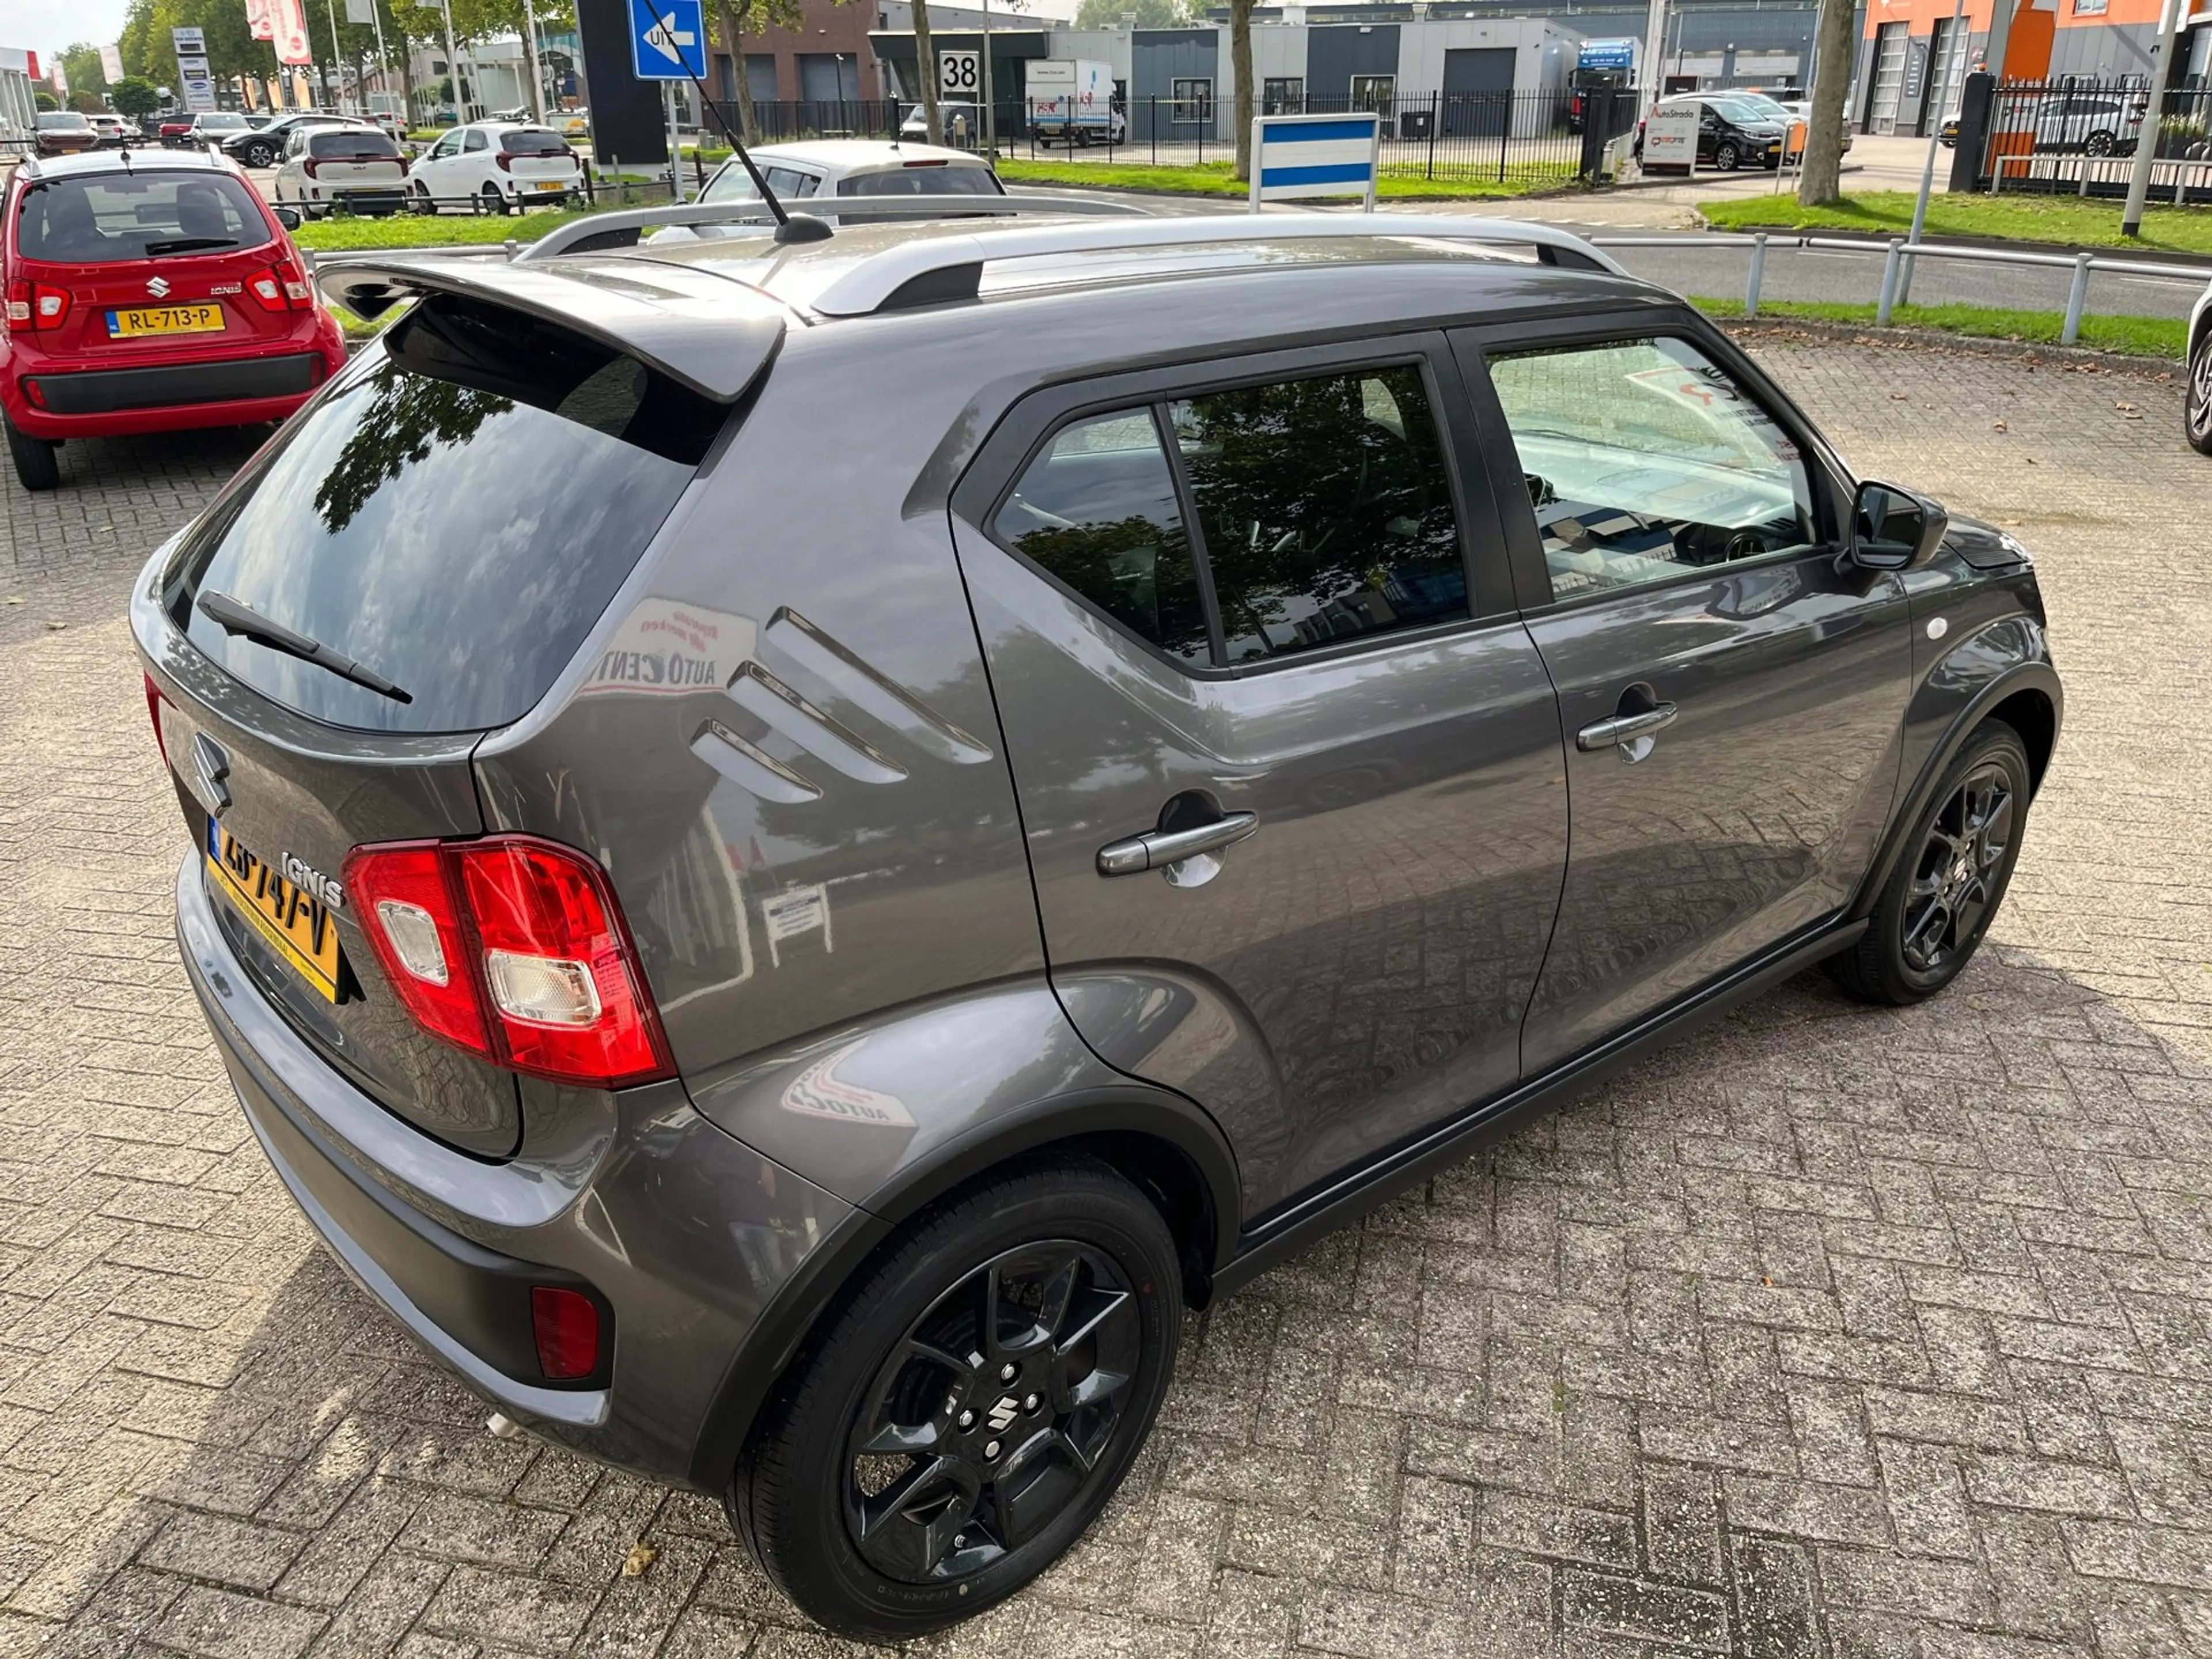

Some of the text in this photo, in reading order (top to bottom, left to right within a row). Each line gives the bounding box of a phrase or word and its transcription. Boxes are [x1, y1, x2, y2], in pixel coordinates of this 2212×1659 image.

[944, 56, 976, 88] 38
[128, 308, 210, 329] RL-713-P
[282, 851, 344, 908] IGNIS
